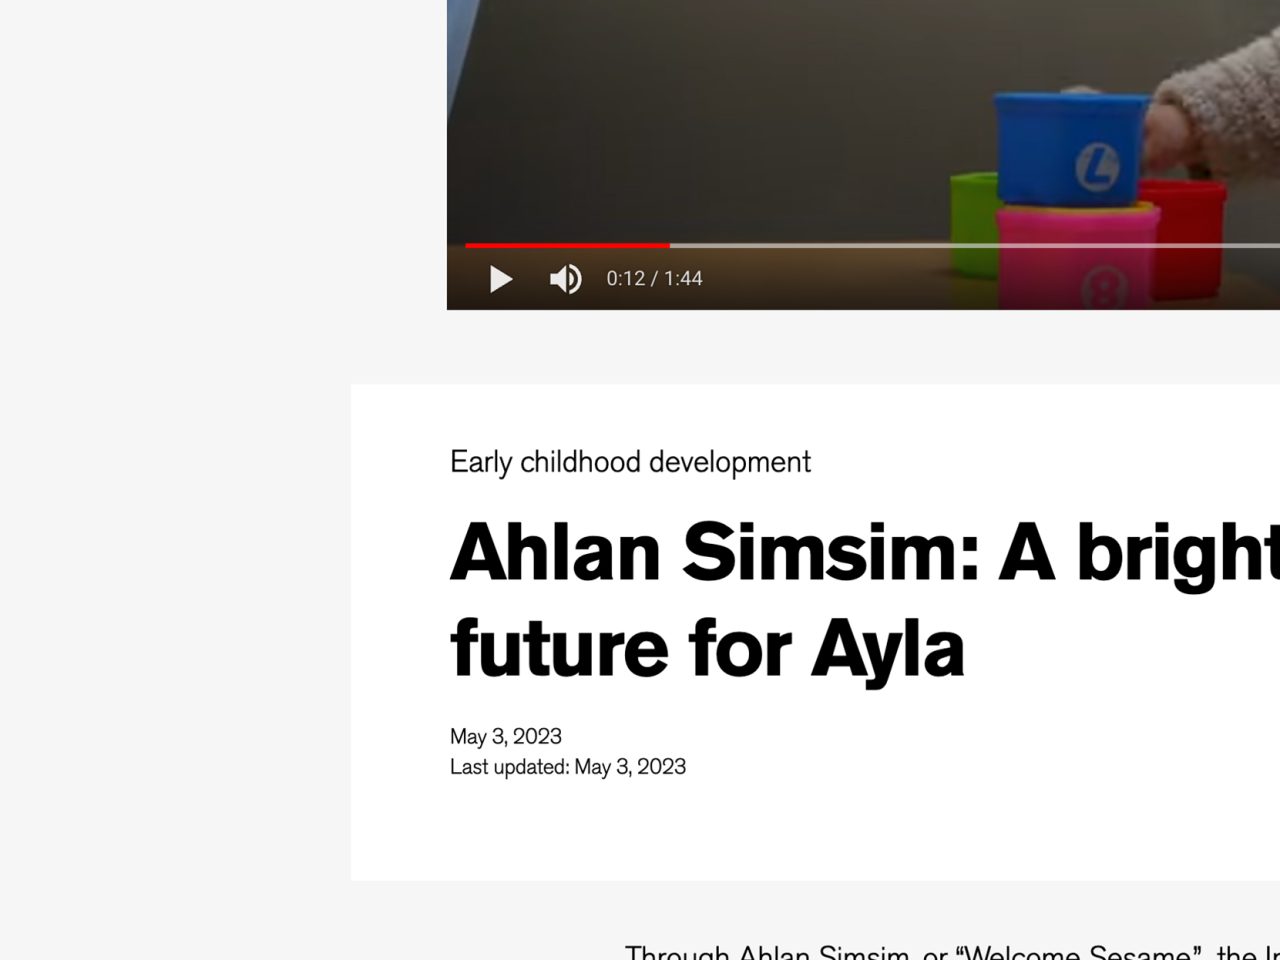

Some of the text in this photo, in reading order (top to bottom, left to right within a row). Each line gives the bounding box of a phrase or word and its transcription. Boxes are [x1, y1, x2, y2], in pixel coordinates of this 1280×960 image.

[607, 271, 645, 286] 0:12
[665, 271, 703, 286] 1:44
[452, 448, 811, 481] Early childhood development
[450, 521, 659, 581] Ahlan
[683, 520, 977, 581] Simsim:
[998, 522, 1056, 581] A
[450, 617, 964, 691] future for Ayla
[451, 727, 561, 749] May 3, 2023
[451, 757, 686, 780] Last updated: May 3, 2023
